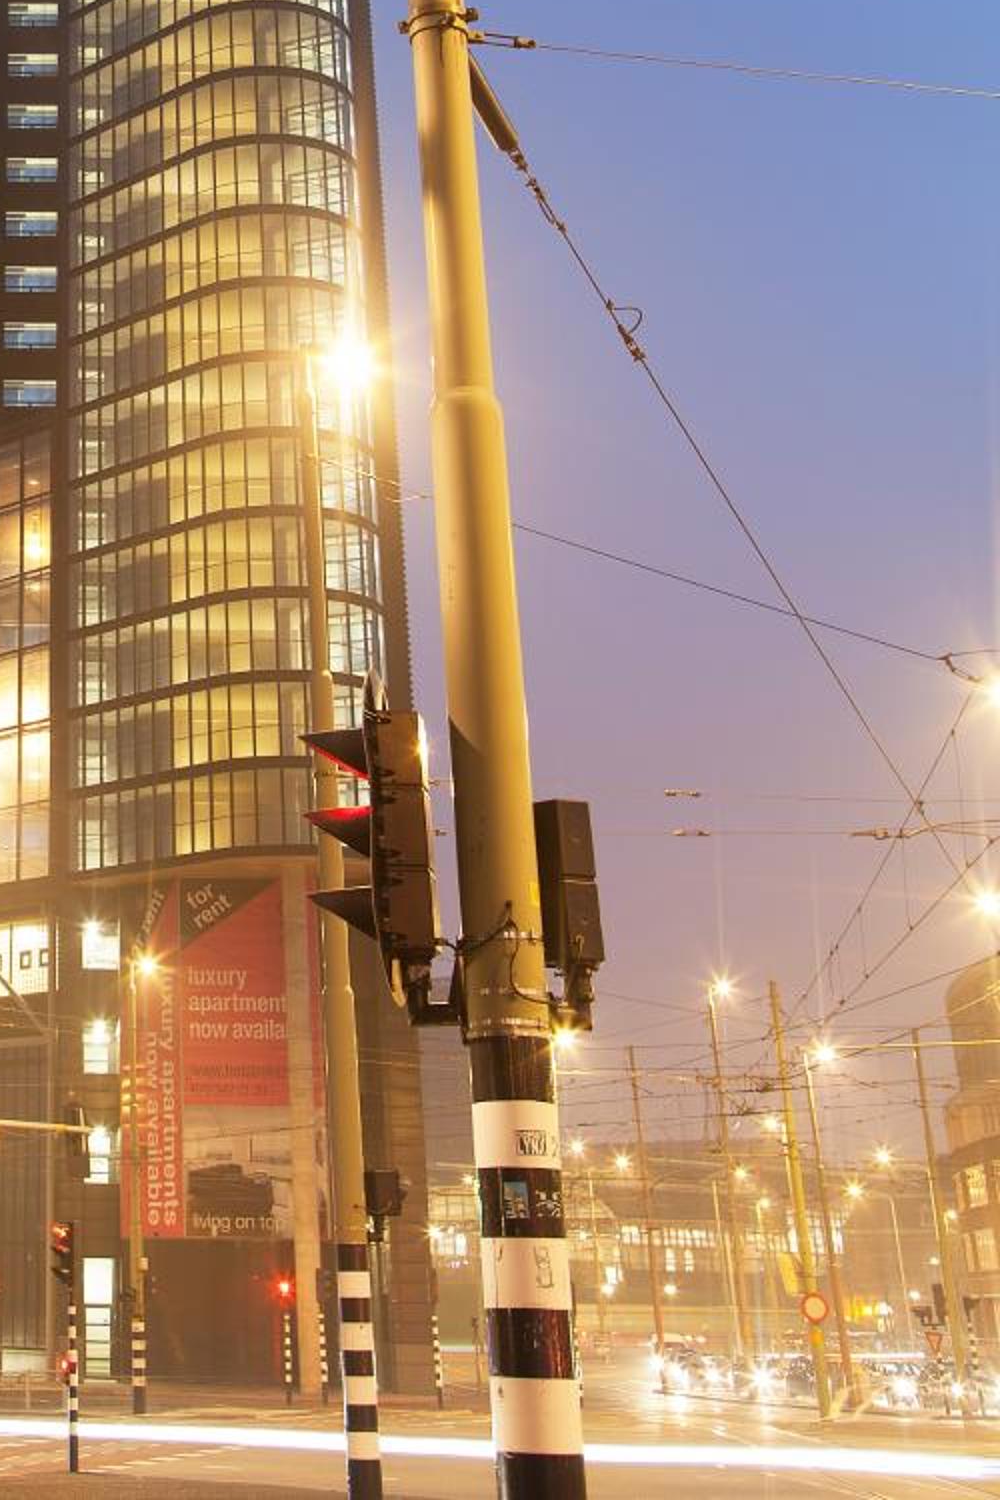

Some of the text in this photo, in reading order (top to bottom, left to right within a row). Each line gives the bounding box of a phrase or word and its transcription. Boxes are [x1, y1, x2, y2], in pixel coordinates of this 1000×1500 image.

[186, 884, 213, 909] for
[193, 894, 233, 930] rent
[188, 965, 247, 991] luxury
[188, 993, 287, 1015] apartment
[190, 1019, 288, 1040] now availa
[145, 1031, 163, 1227] now available
[159, 1059, 179, 1227] apartments
[235, 1217, 256, 1230] on
